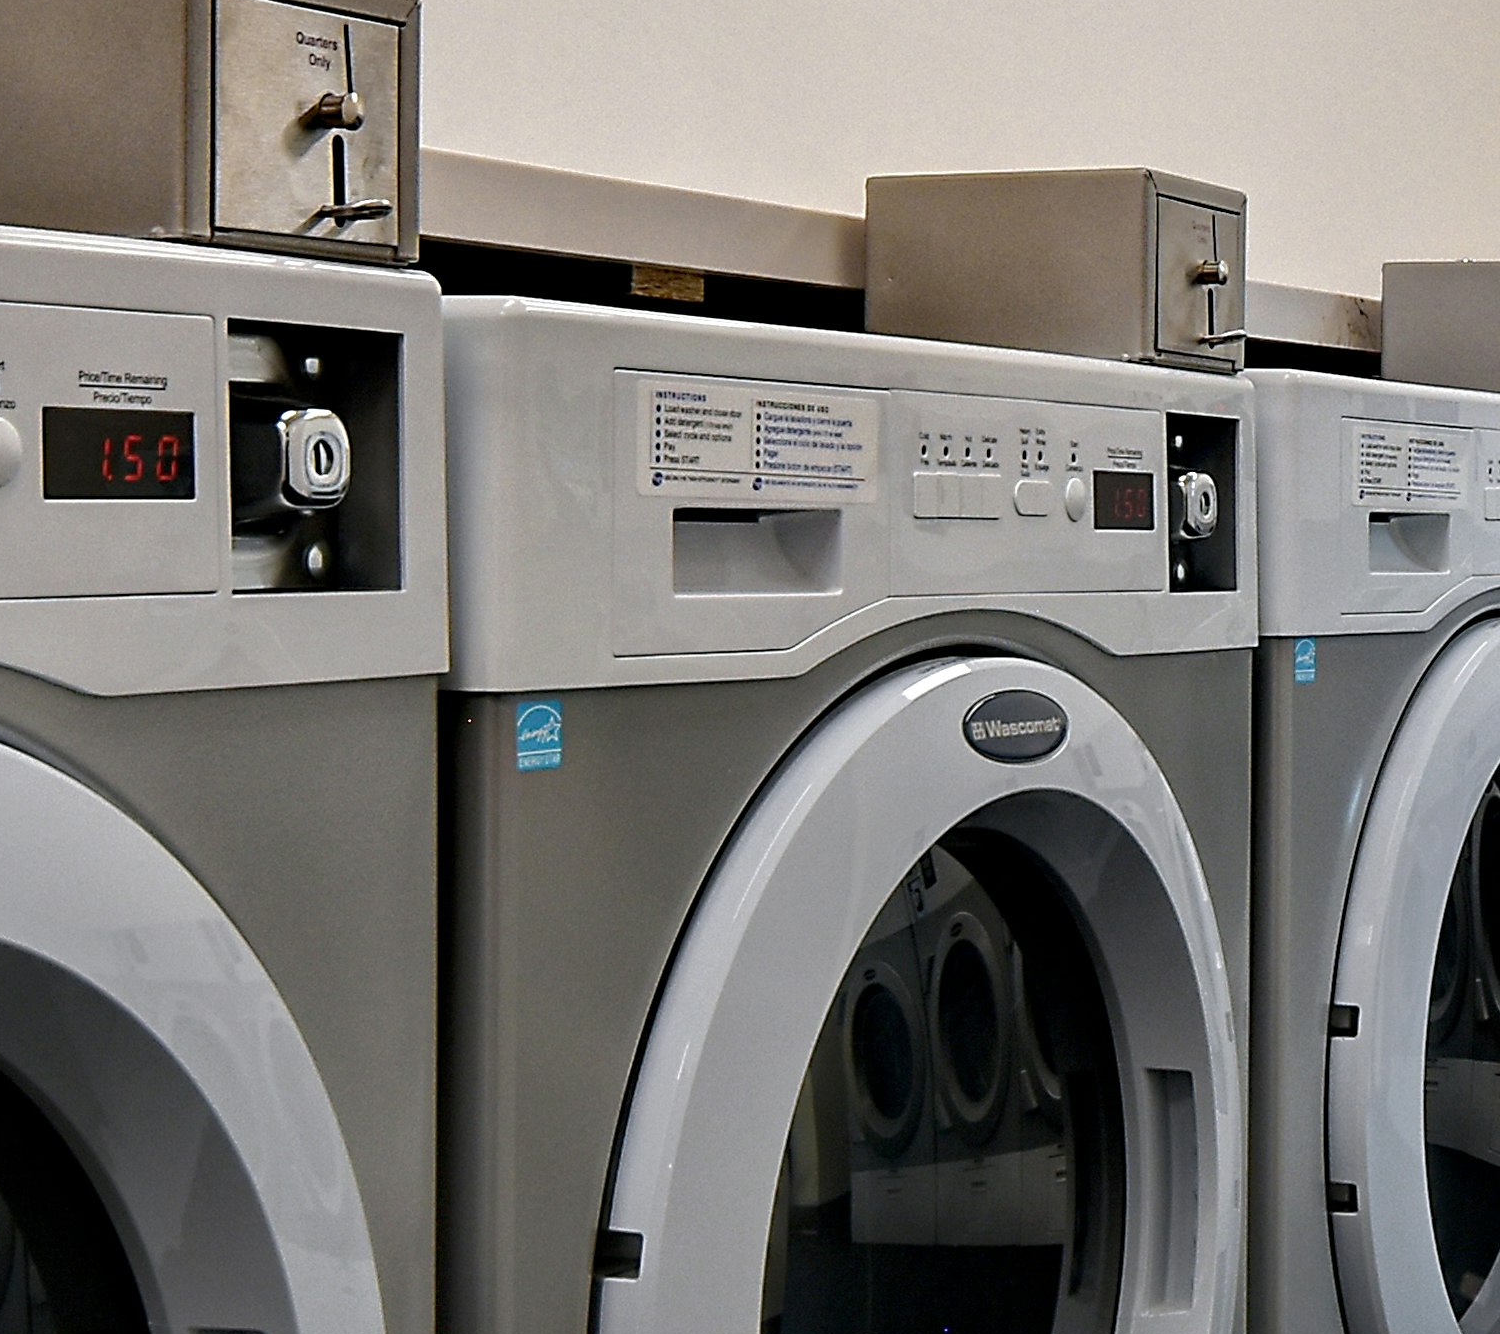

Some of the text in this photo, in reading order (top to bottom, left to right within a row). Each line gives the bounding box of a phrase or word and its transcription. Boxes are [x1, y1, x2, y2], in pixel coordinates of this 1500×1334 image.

[296, 31, 338, 51] Quarters
[309, 53, 331, 71] Only
[124, 372, 168, 388] Remaining
[93, 390, 153, 406] Precio/Tiempo
[985, 717, 1061, 739] Wascomat
